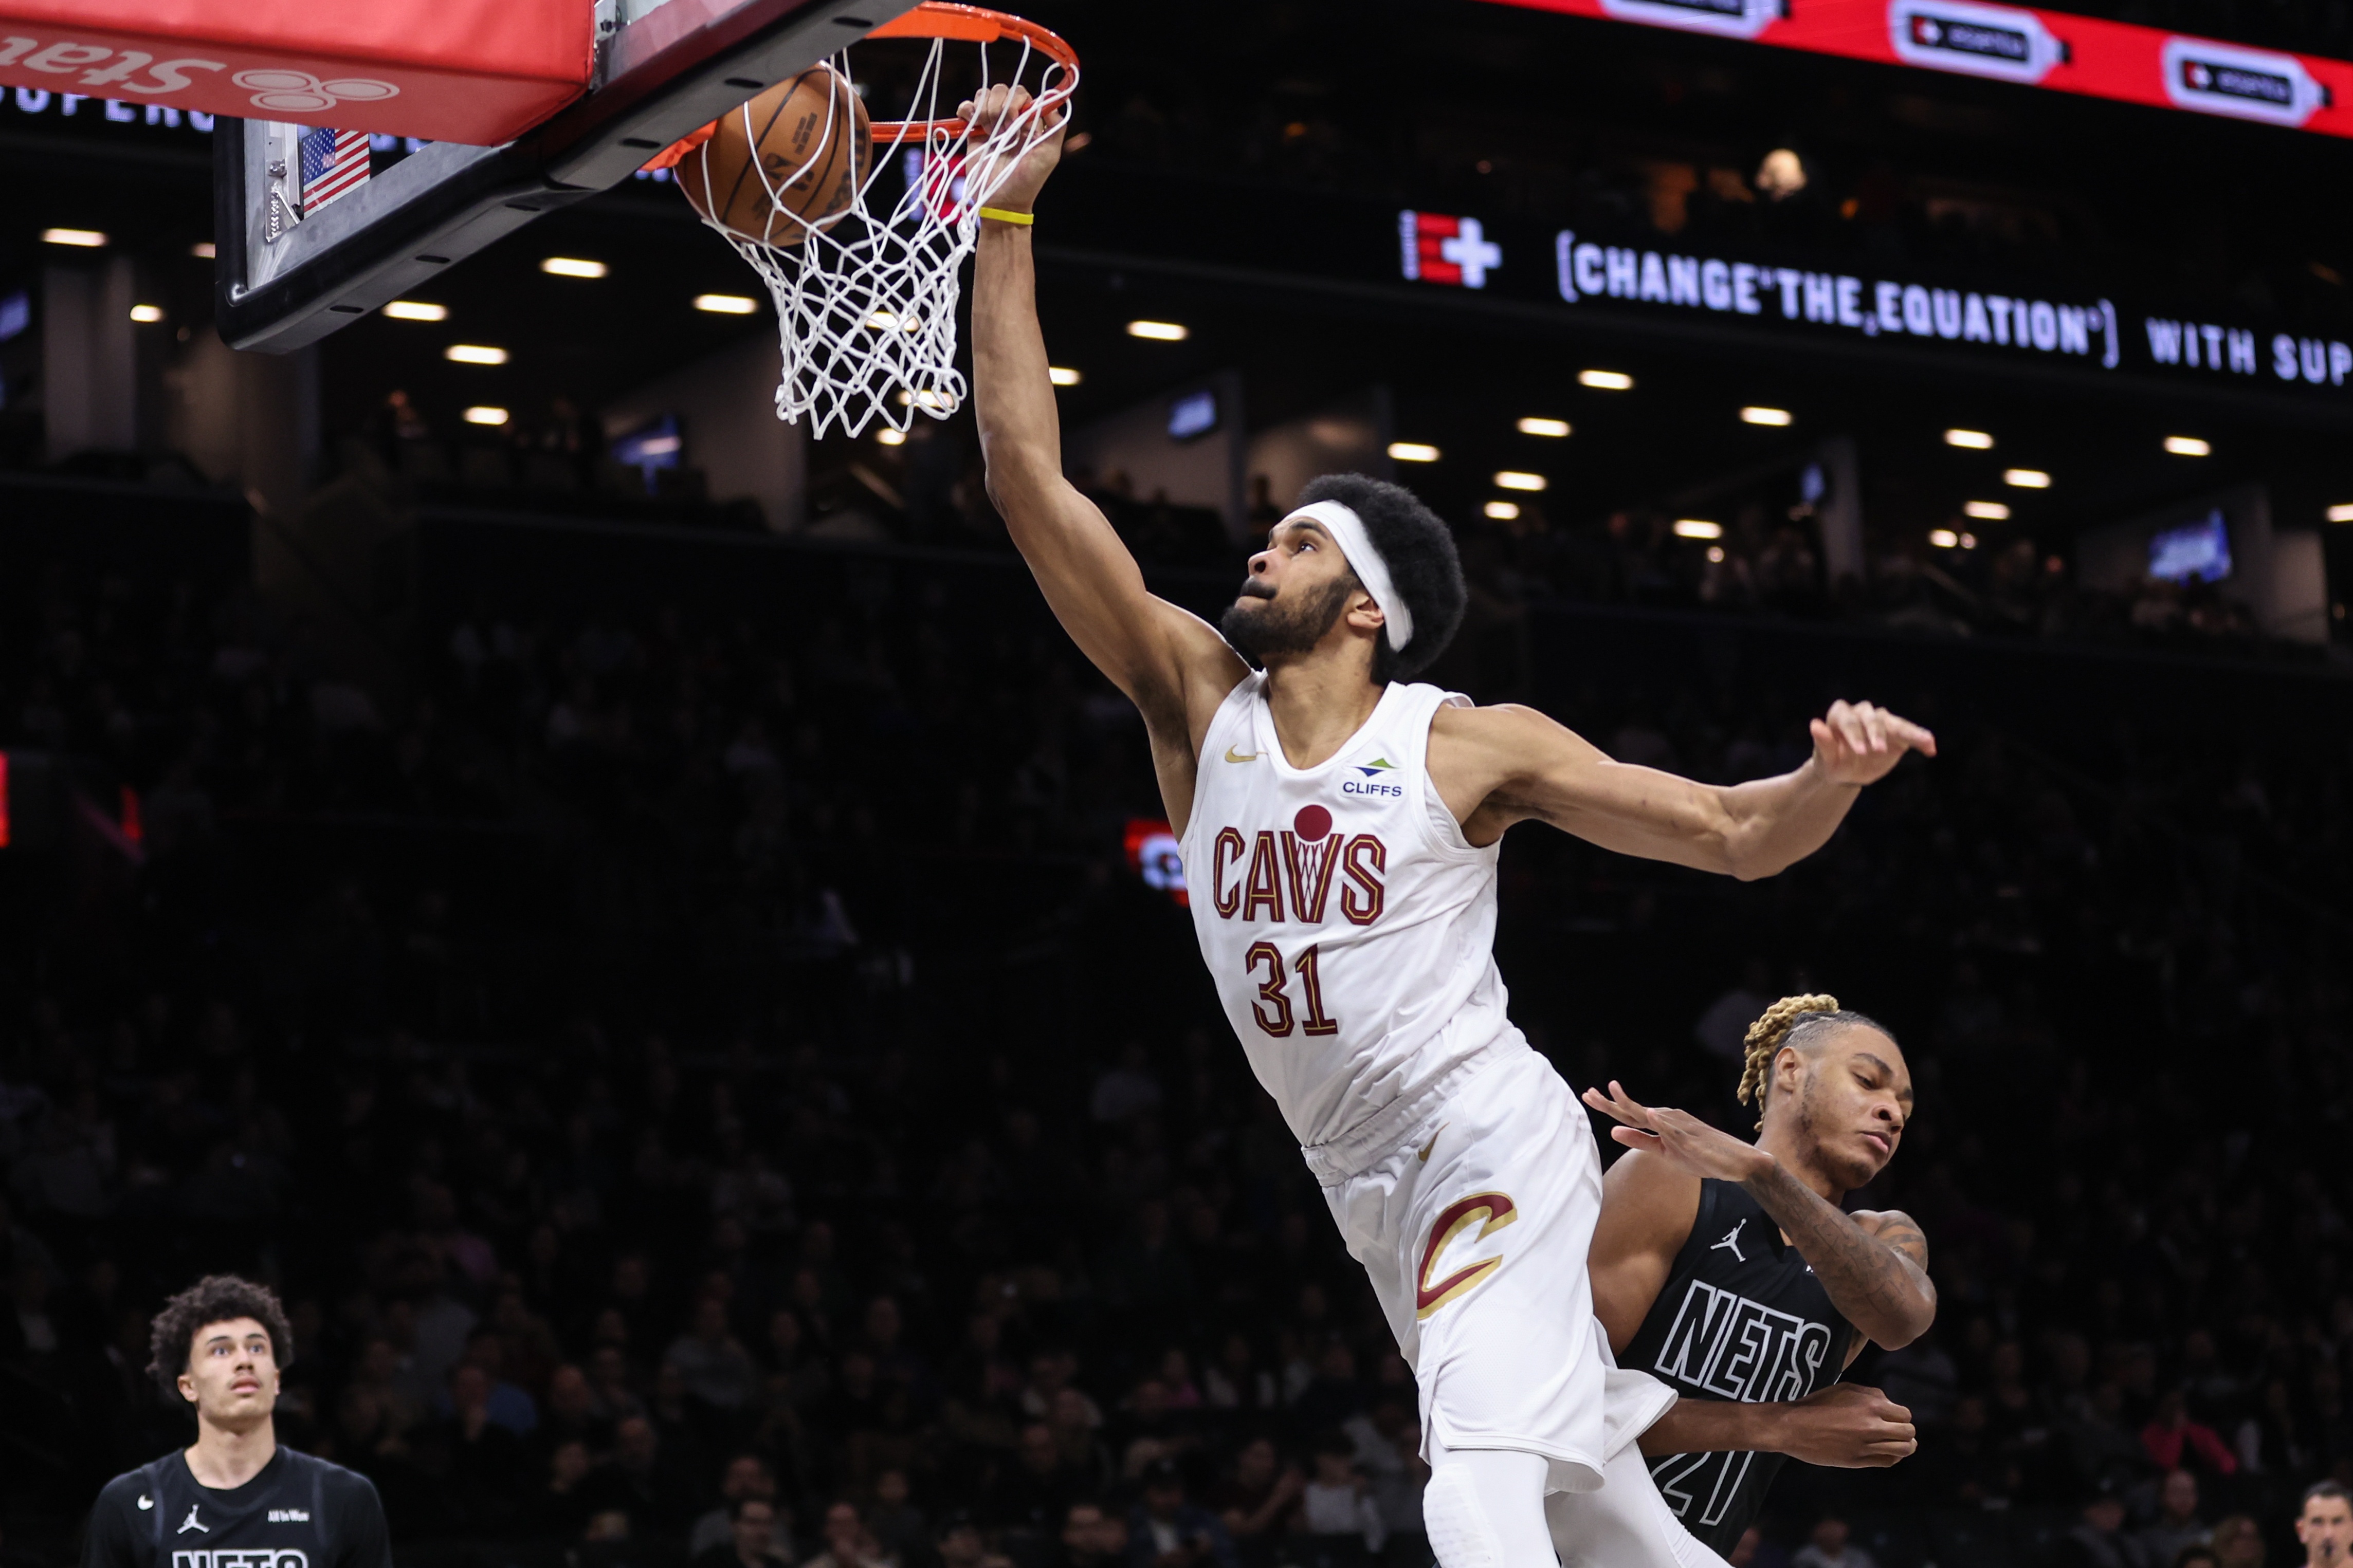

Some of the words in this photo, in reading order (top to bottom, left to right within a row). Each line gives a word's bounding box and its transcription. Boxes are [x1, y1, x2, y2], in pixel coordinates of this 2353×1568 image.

[2145, 317, 2256, 375] WITH
[2272, 333, 2353, 386] SUP
[1343, 782, 1402, 797] CLIFFS
[1213, 826, 1387, 926] CAVS
[1245, 941, 1339, 1038] 31
[1654, 1279, 1832, 1403] NETS
